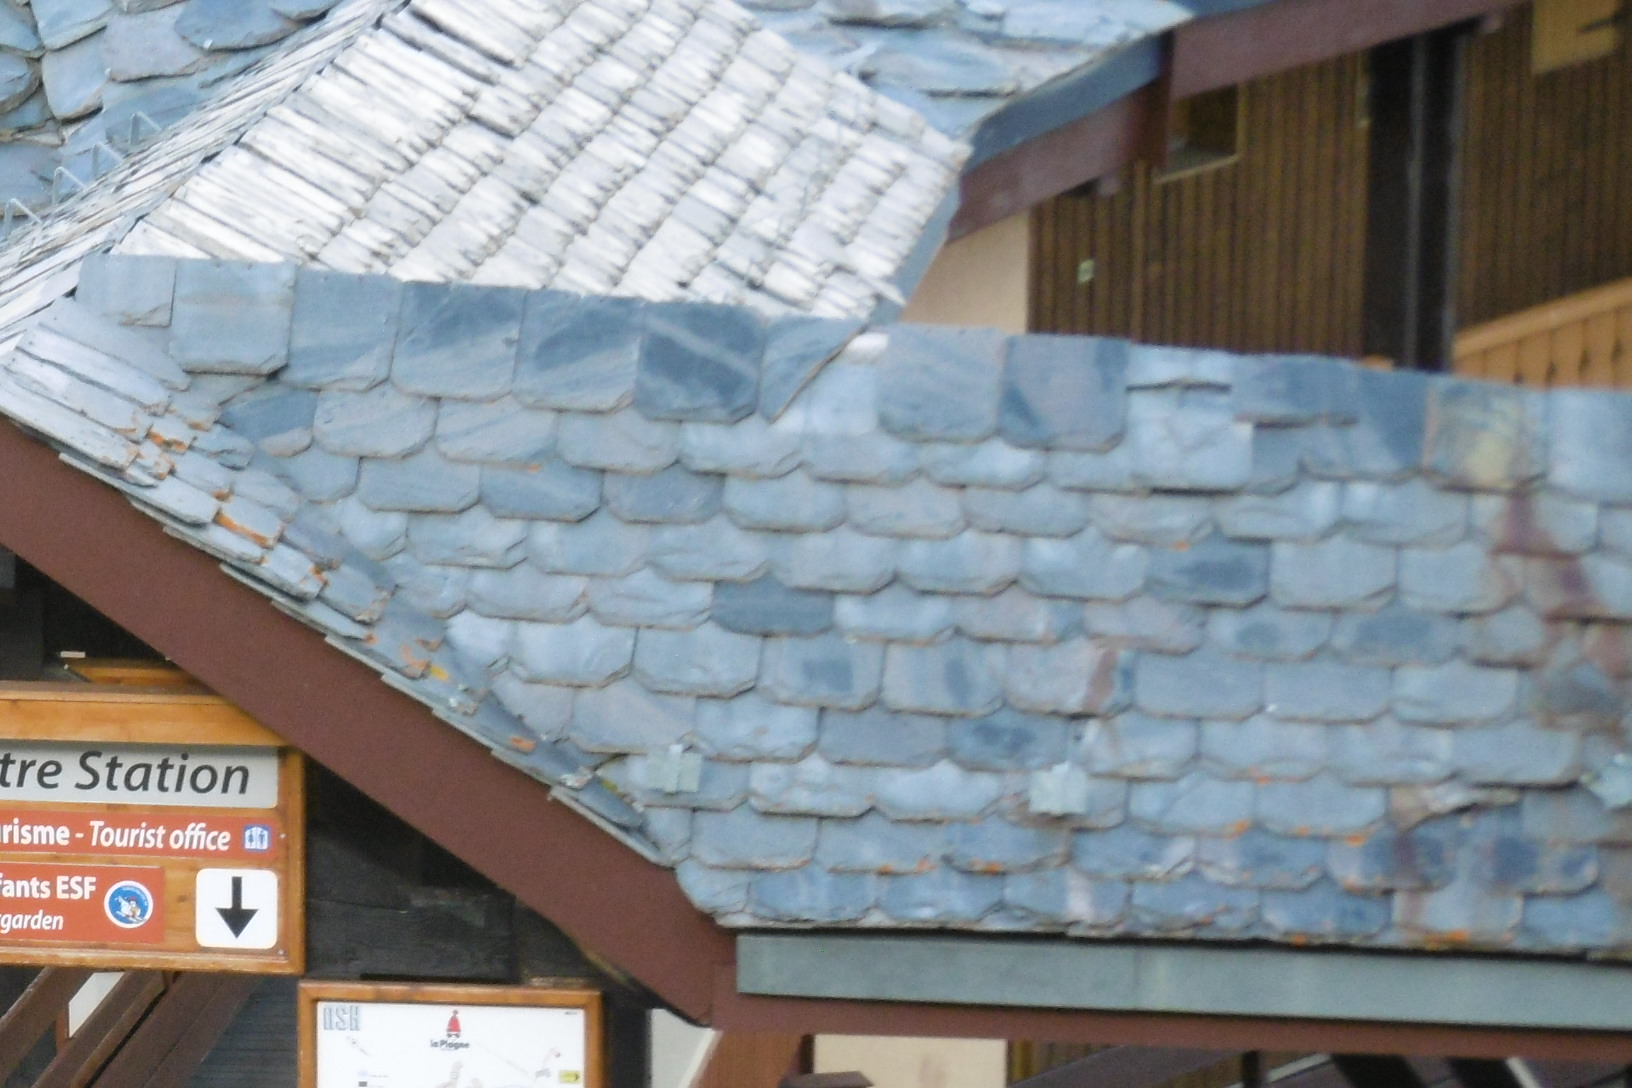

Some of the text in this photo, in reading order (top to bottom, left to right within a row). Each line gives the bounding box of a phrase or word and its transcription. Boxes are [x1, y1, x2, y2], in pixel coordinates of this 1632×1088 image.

[74, 750, 250, 795] Station
[89, 820, 165, 849] Tourist
[169, 823, 231, 851] office
[56, 876, 96, 900] ESF
